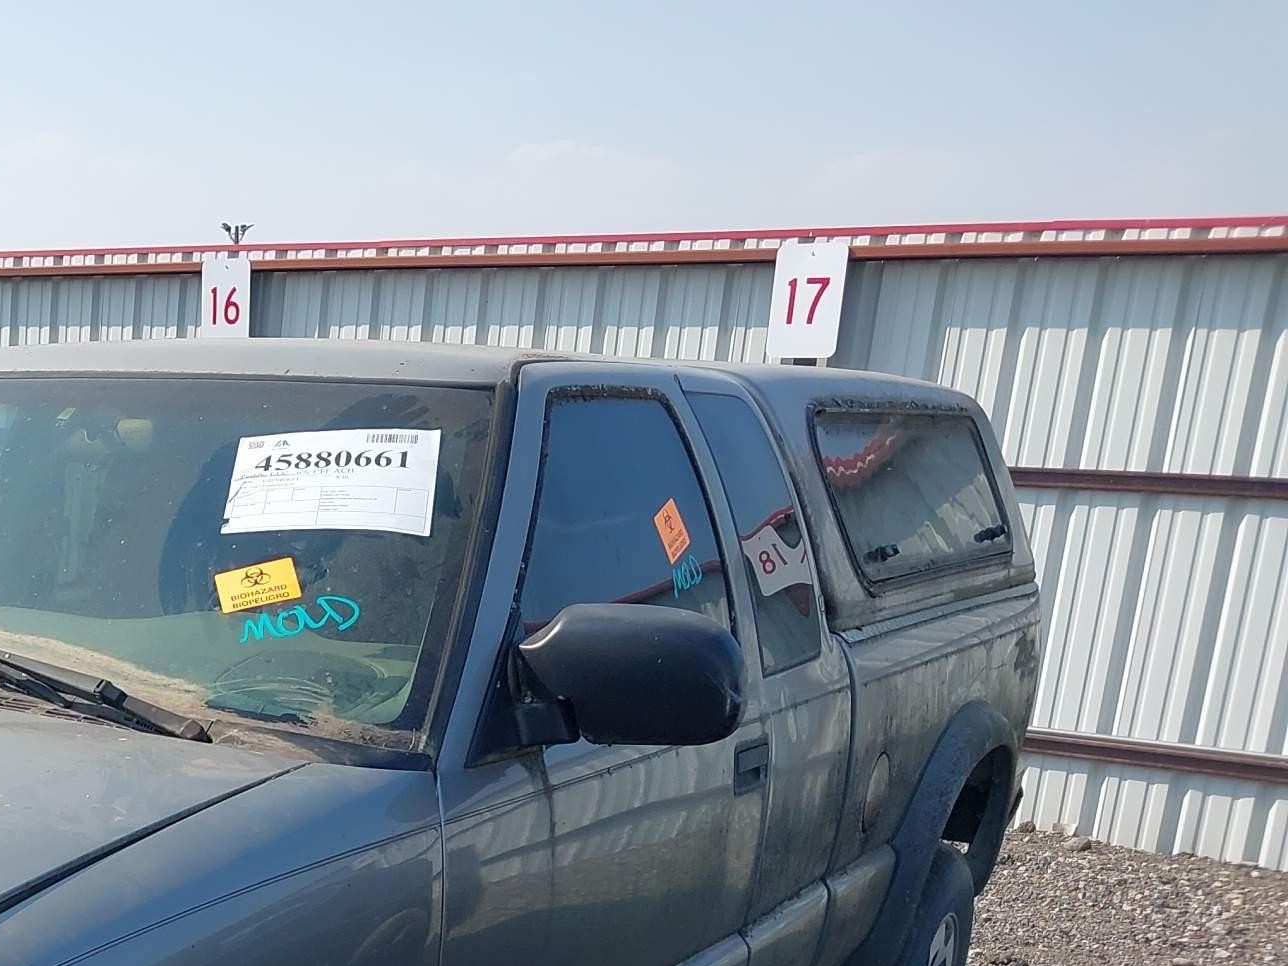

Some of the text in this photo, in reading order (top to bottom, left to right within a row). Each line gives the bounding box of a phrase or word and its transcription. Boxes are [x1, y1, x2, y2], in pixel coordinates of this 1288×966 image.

[211, 286, 240, 325] 16
[785, 277, 831, 325] 17
[255, 449, 410, 472] 45880661
[230, 584, 288, 601] BIOHAZARD
[232, 592, 290, 608] BIOPELIGRO
[239, 594, 361, 643] MOLD
